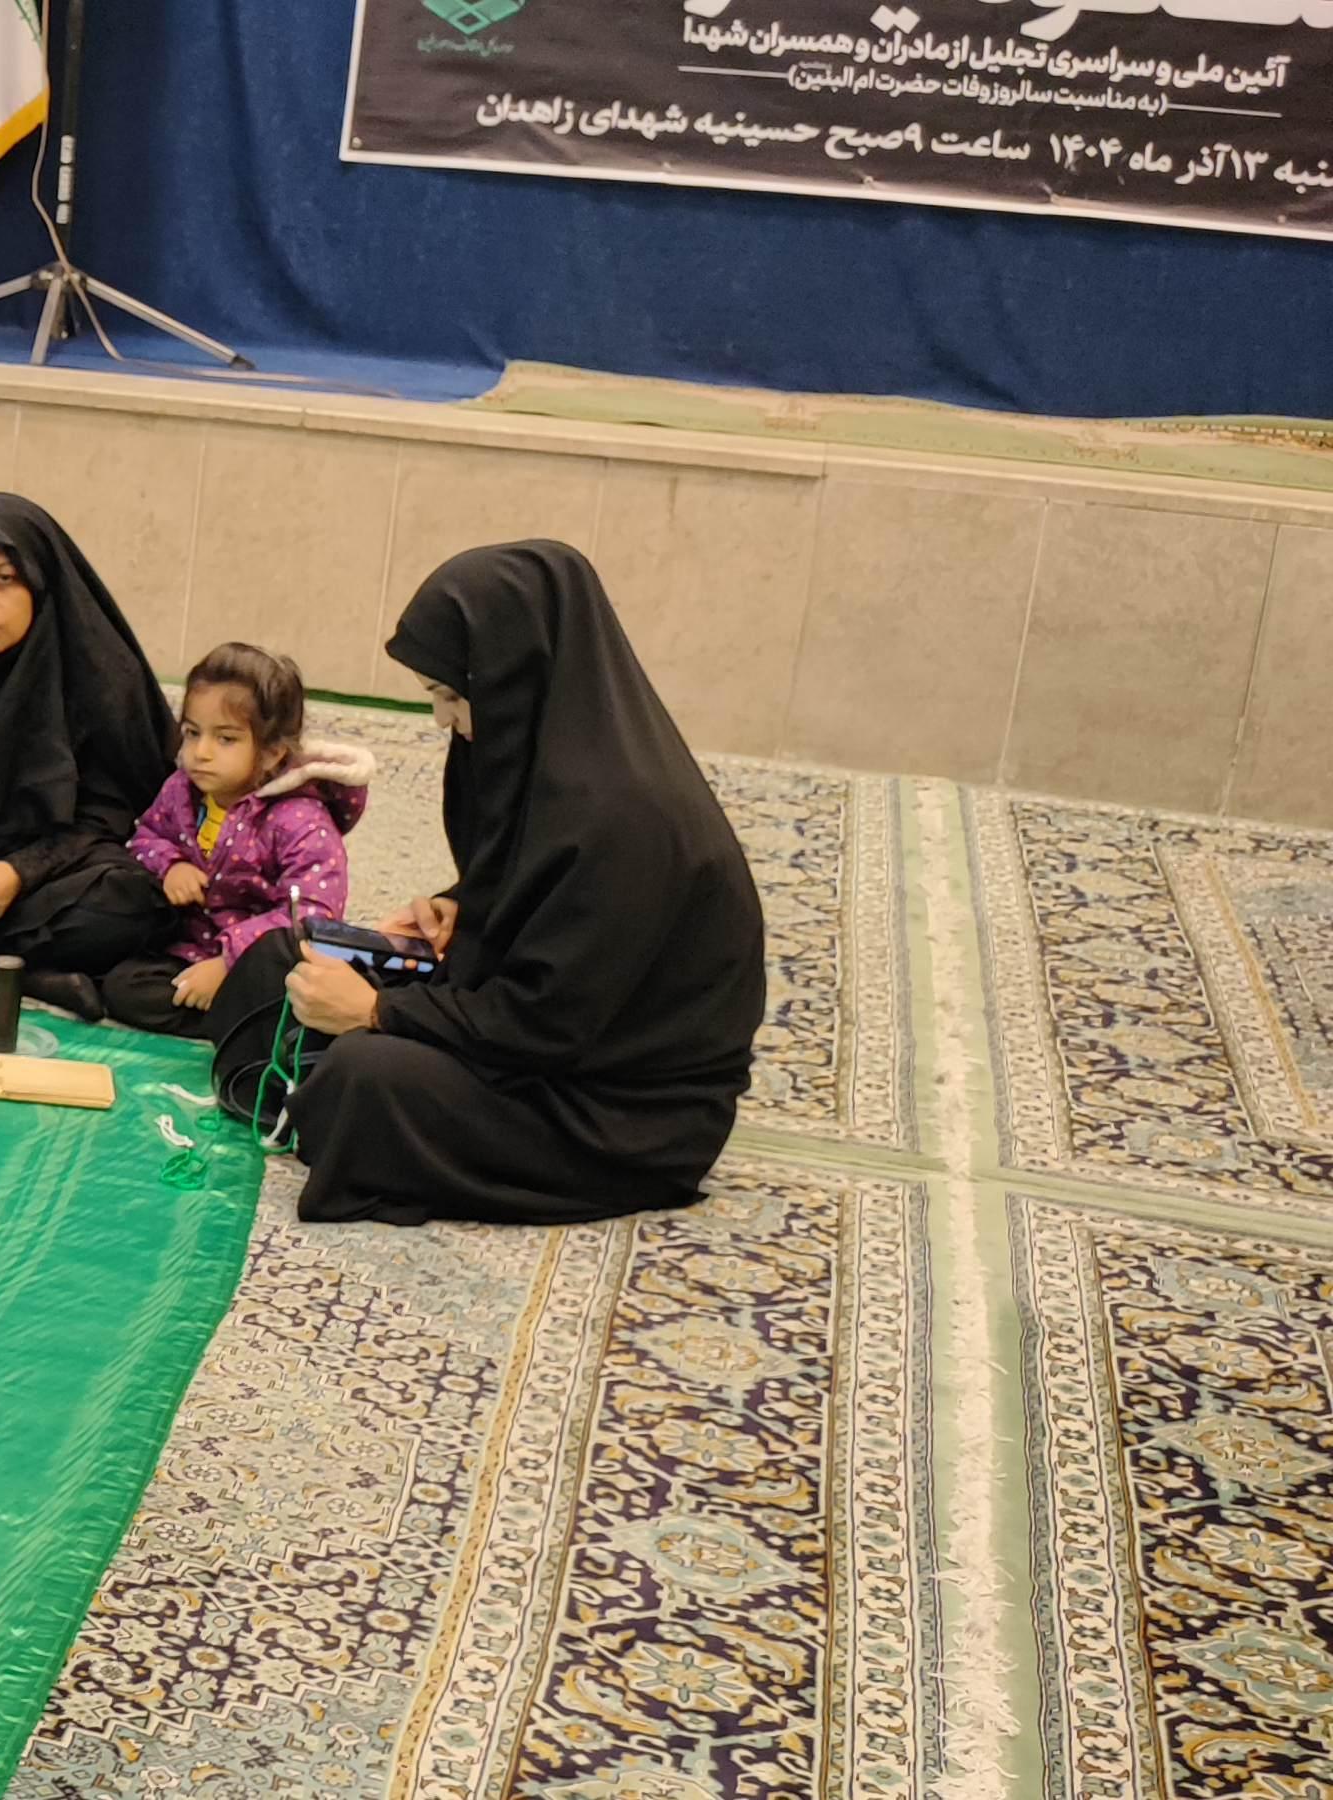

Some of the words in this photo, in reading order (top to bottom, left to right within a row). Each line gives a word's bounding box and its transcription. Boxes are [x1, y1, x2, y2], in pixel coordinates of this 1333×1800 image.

[684, 16, 749, 52] شهدا
[749, 21, 854, 57] همسران
[854, 36, 872, 63] و
[872, 30, 950, 66] مادران
[946, 34, 969, 70] از
[969, 36, 1050, 75] تجلیل
[1047, 46, 1155, 83] سراسری
[853, 68, 875, 95] ام
[875, 72, 942, 98] حضرت
[1156, 60, 1172, 86] و
[1172, 53, 1224, 88] ملی
[1224, 54, 1291, 95] آئین
[942, 75, 991, 104] وفات
[1053, 86, 1135, 112] مناسبت
[476, 92, 574, 134] زاهدان
[579, 101, 688, 141] شهدای
[693, 111, 821, 147] حسینیه
[931, 129, 1031, 160] ساعت
[1050, 133, 1123, 168] ۱۴۰۴
[1129, 142, 1173, 173] ماه
